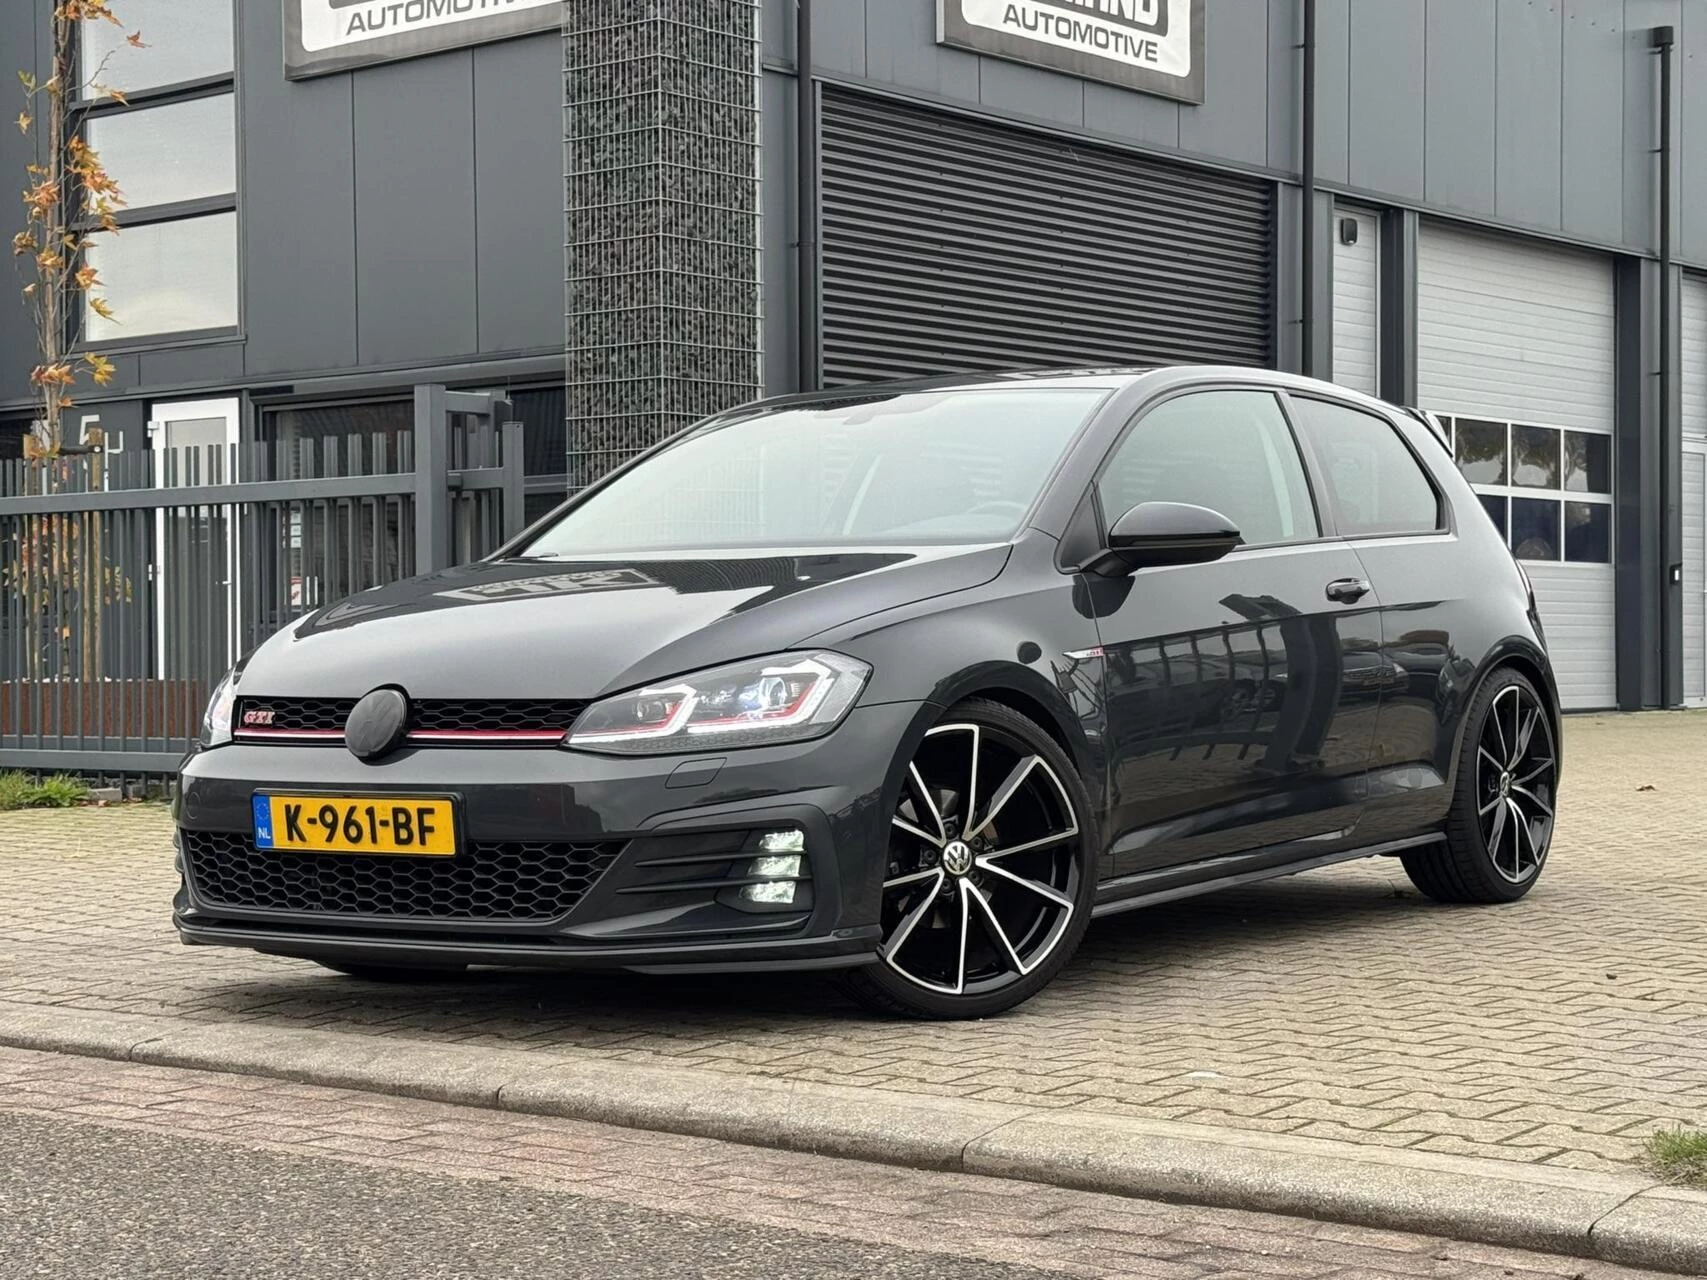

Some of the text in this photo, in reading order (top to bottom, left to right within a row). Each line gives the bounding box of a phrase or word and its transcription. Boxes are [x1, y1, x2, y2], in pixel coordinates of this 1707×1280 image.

[345, 0, 514, 35] AUTOMO
[1003, 4, 1158, 63] AUTOMOTIVE
[244, 711, 275, 724] GTI
[258, 827, 271, 840] NL
[284, 803, 436, 846] K-961-BF
